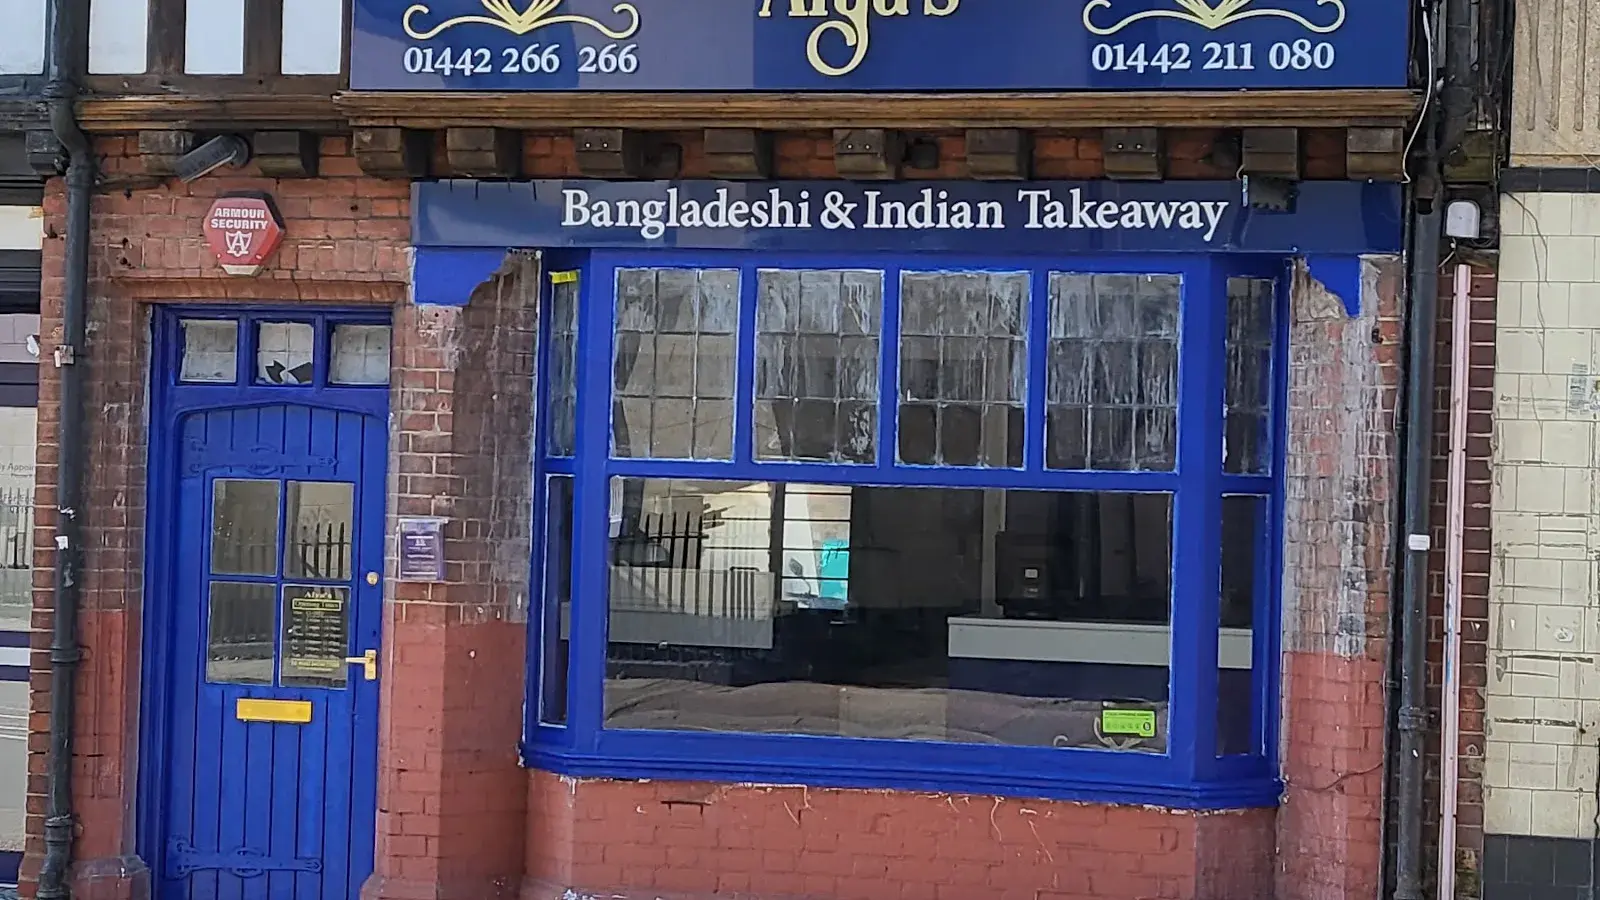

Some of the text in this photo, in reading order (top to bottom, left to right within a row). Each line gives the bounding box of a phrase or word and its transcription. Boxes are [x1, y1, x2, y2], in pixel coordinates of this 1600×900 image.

[403, 43, 639, 76] 01442 266 266
[1091, 38, 1335, 74] 01442 211 080
[210, 218, 269, 230] SECURITY
[214, 207, 265, 219] ARMOUR
[561, 187, 1230, 242] Bangladeshi & Indian Takeaway
